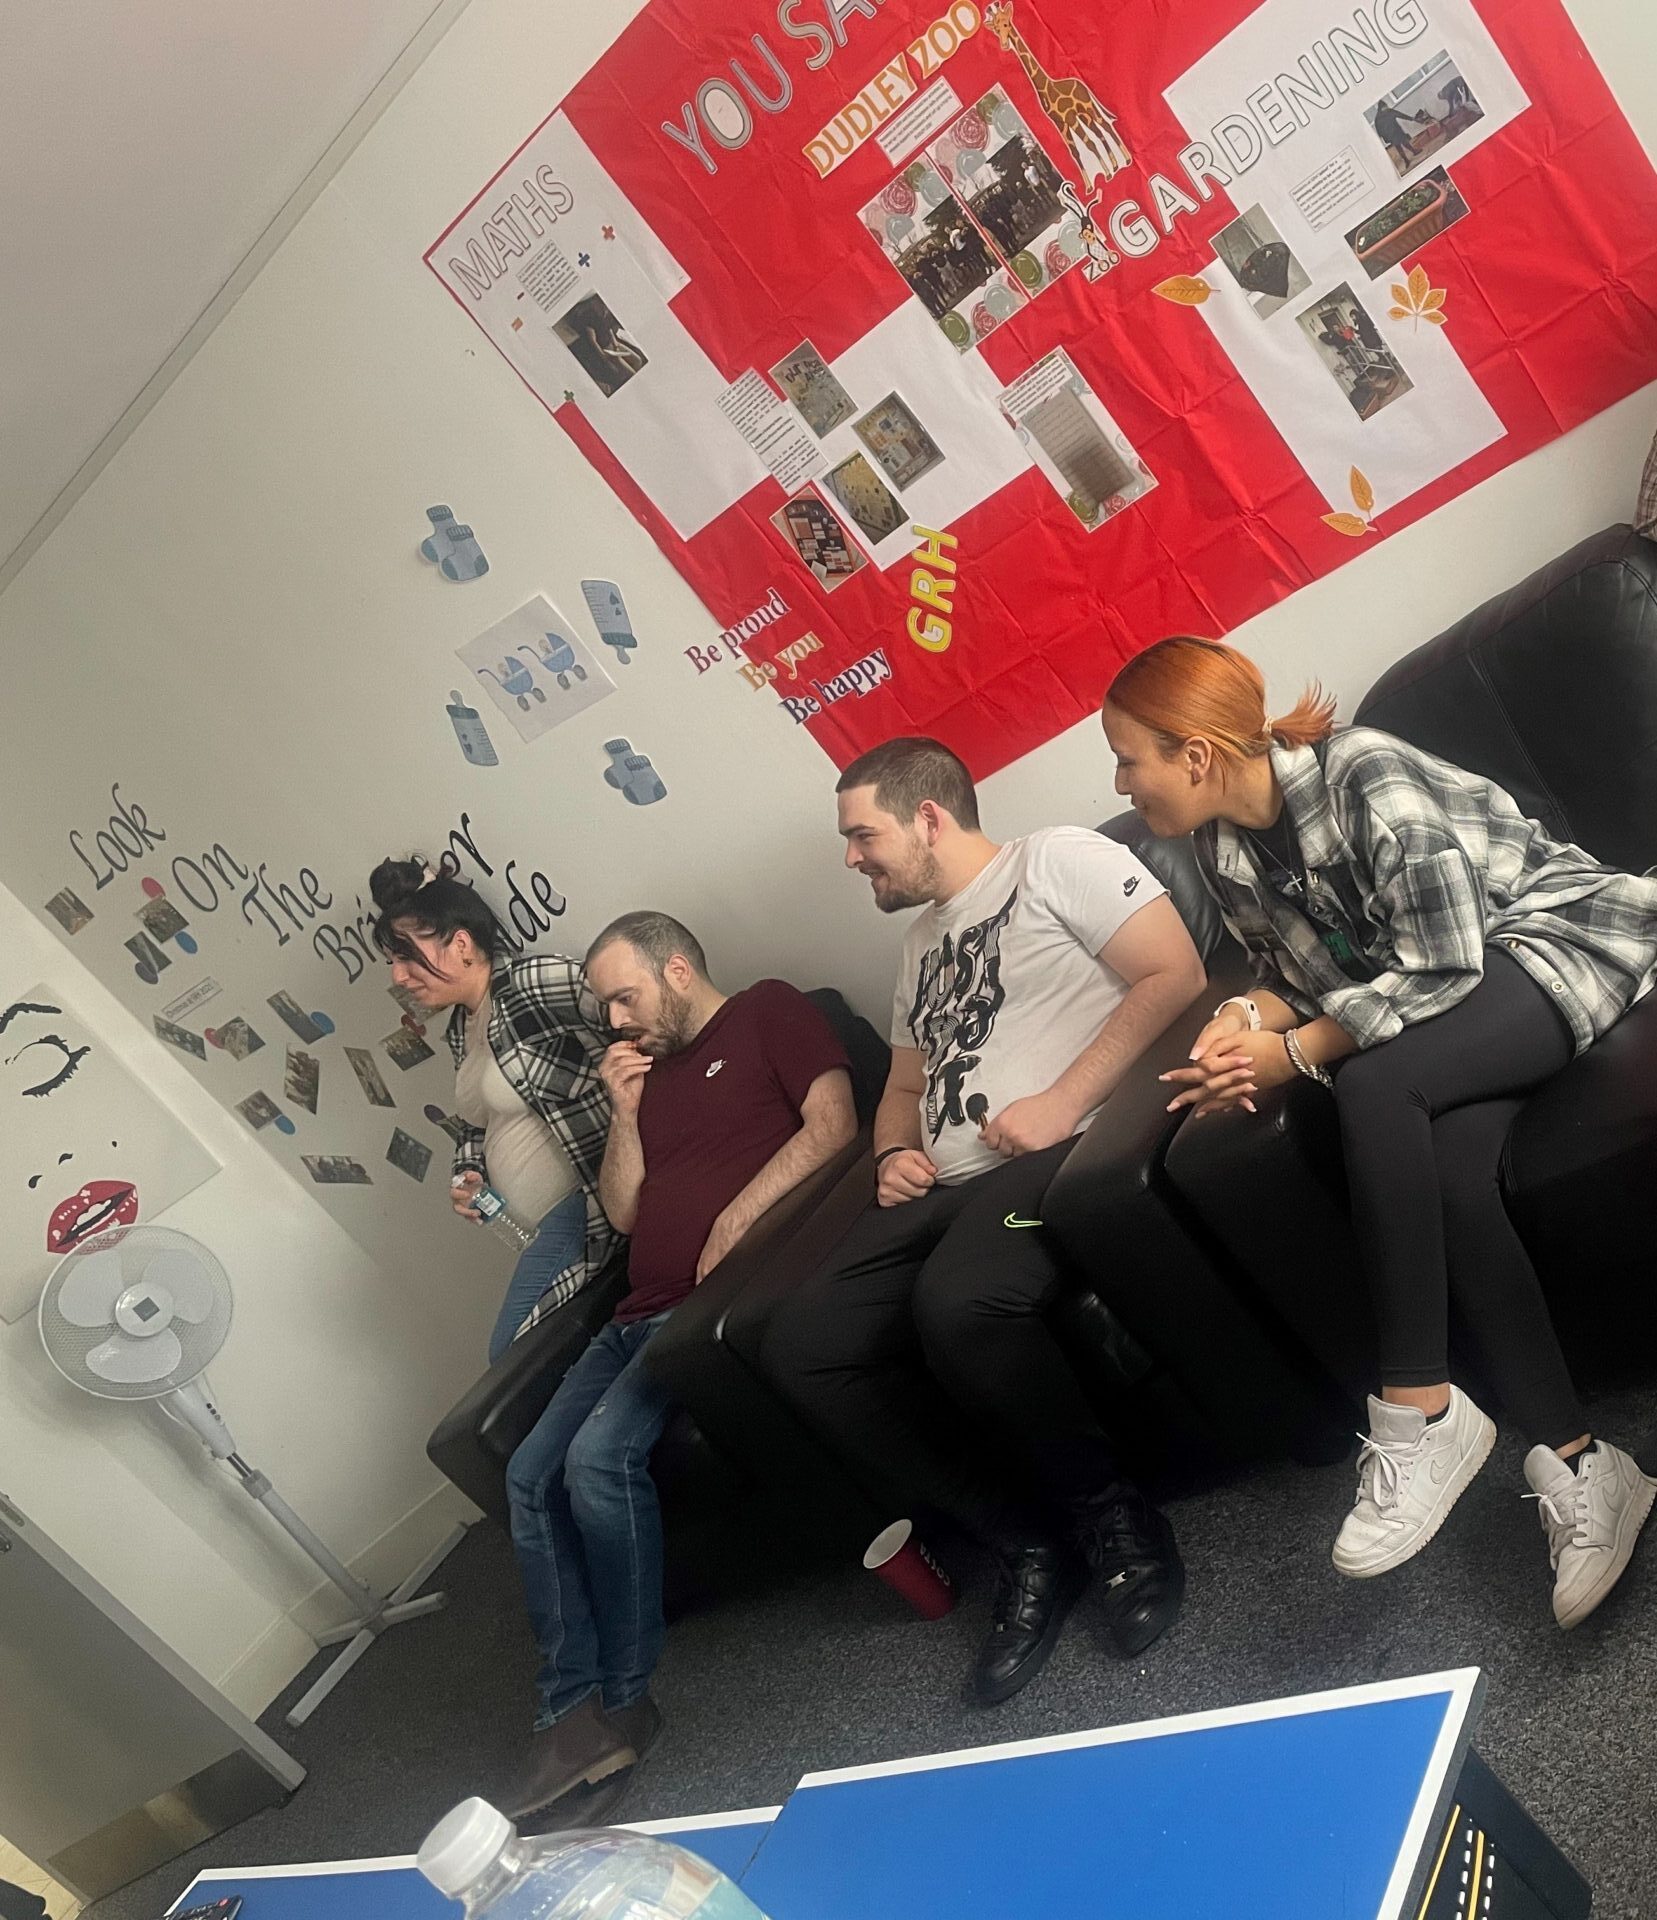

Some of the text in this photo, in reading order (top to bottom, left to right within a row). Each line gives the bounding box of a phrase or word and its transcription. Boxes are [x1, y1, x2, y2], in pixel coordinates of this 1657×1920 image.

[661, 34, 792, 174] YOU
[803, 57, 918, 177] DUDLEY
[907, 0, 980, 78] ZOO
[1110, 0, 1429, 257] GARDENING
[449, 164, 574, 300] MATHS
[684, 587, 791, 676] Be proud
[906, 523, 959, 653] GRH
[737, 630, 824, 691] Be you
[778, 647, 893, 725] Be happy
[69, 782, 167, 890] Look
[172, 843, 249, 912] On
[241, 862, 333, 947] The
[496, 859, 567, 953] ide
